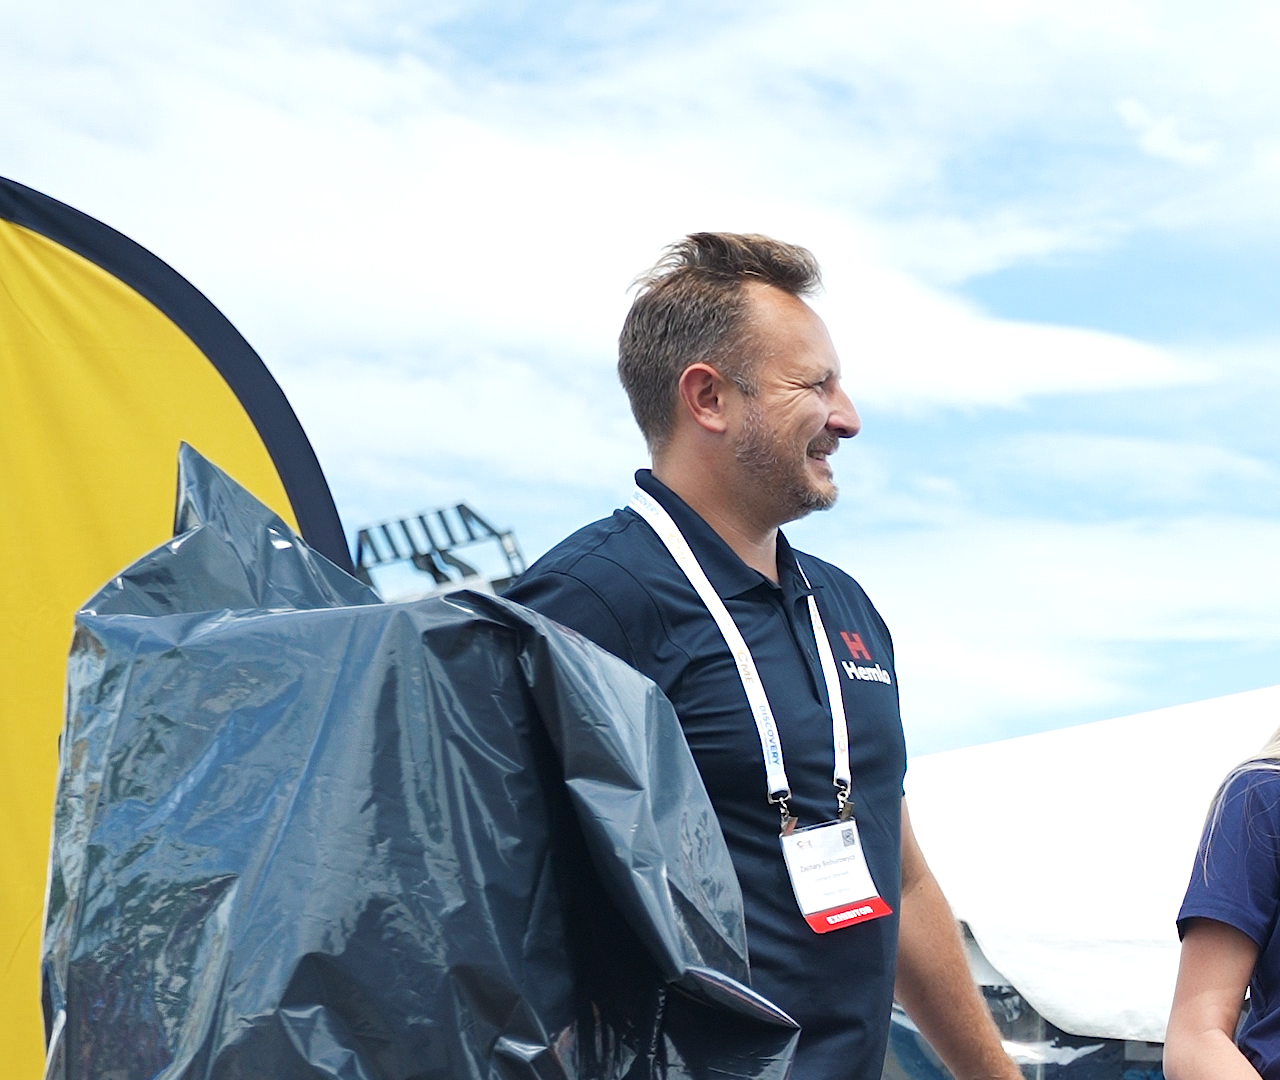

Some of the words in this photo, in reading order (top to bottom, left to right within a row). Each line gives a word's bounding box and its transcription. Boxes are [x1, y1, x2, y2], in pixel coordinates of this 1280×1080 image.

[841, 660, 891, 685] Hemlo
[759, 705, 780, 765] DISCOVERY
[826, 905, 874, 925] EXHIBITOR
